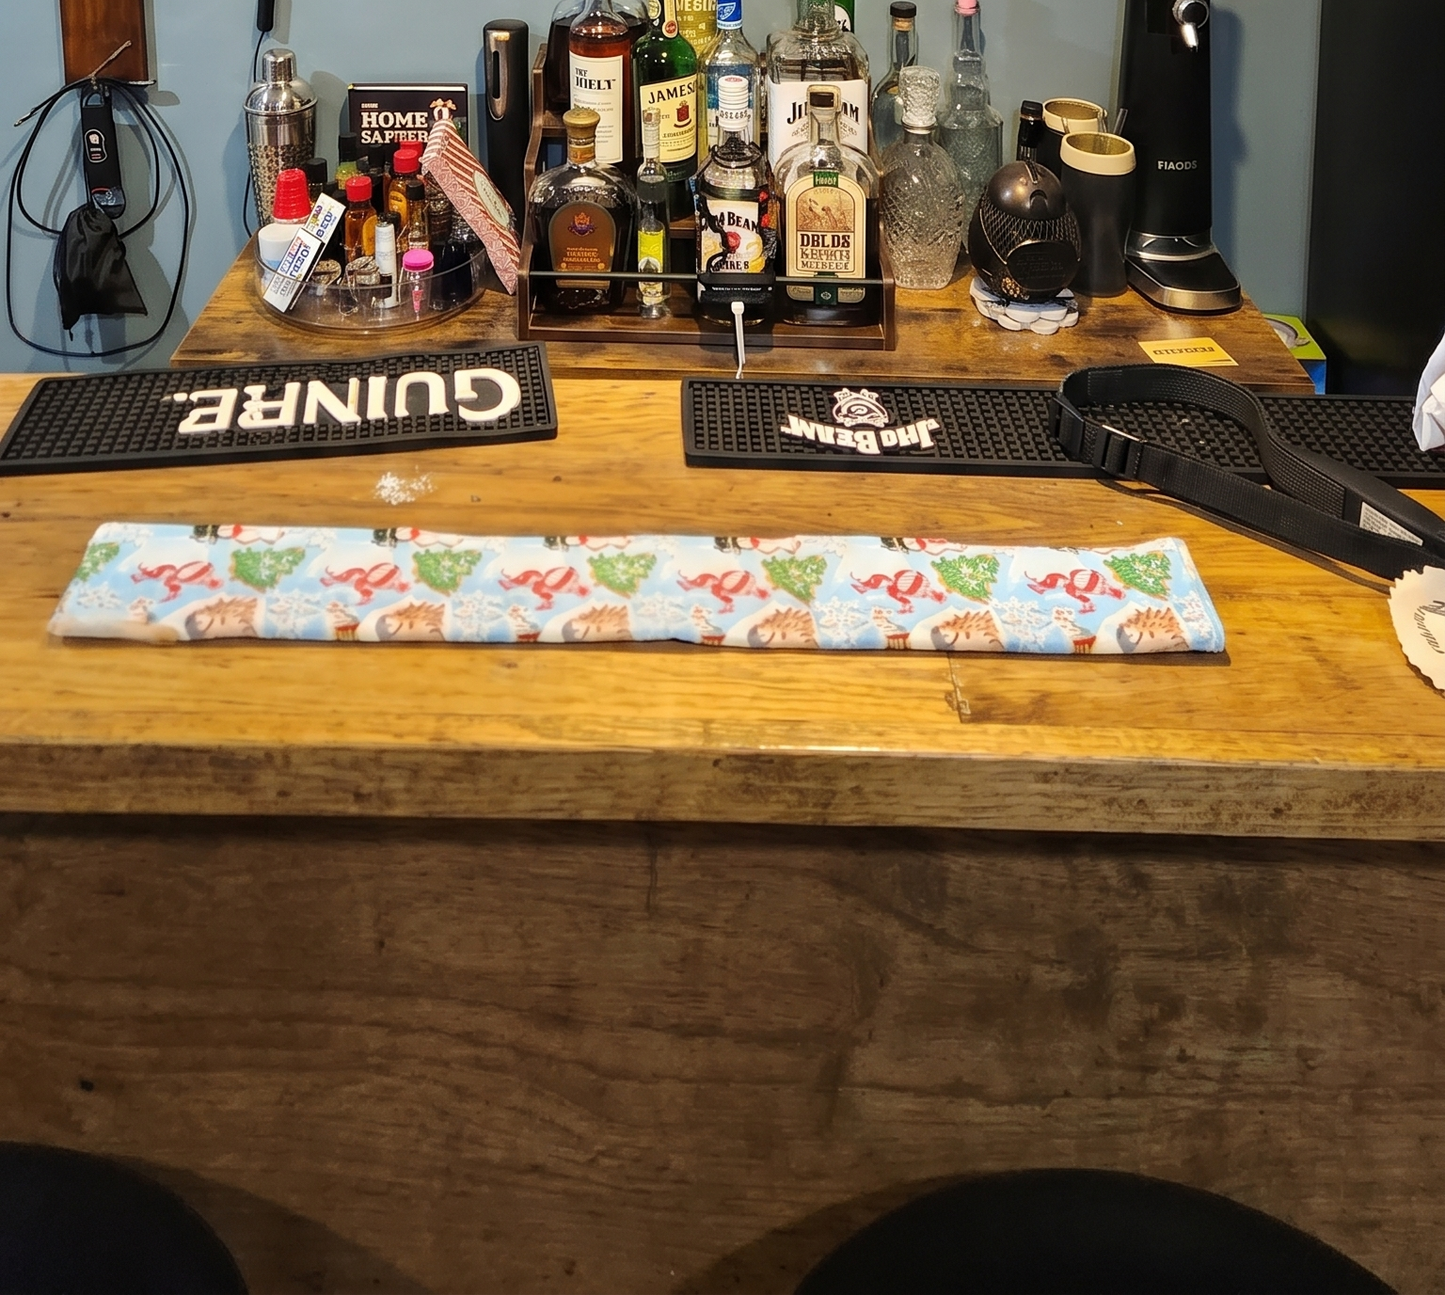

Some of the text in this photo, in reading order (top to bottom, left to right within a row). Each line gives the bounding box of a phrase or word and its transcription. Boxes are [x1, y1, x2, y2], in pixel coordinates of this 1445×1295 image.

[648, 78, 697, 104] JAMES
[361, 111, 429, 129] HOME
[1157, 160, 1198, 170] FIAODS
